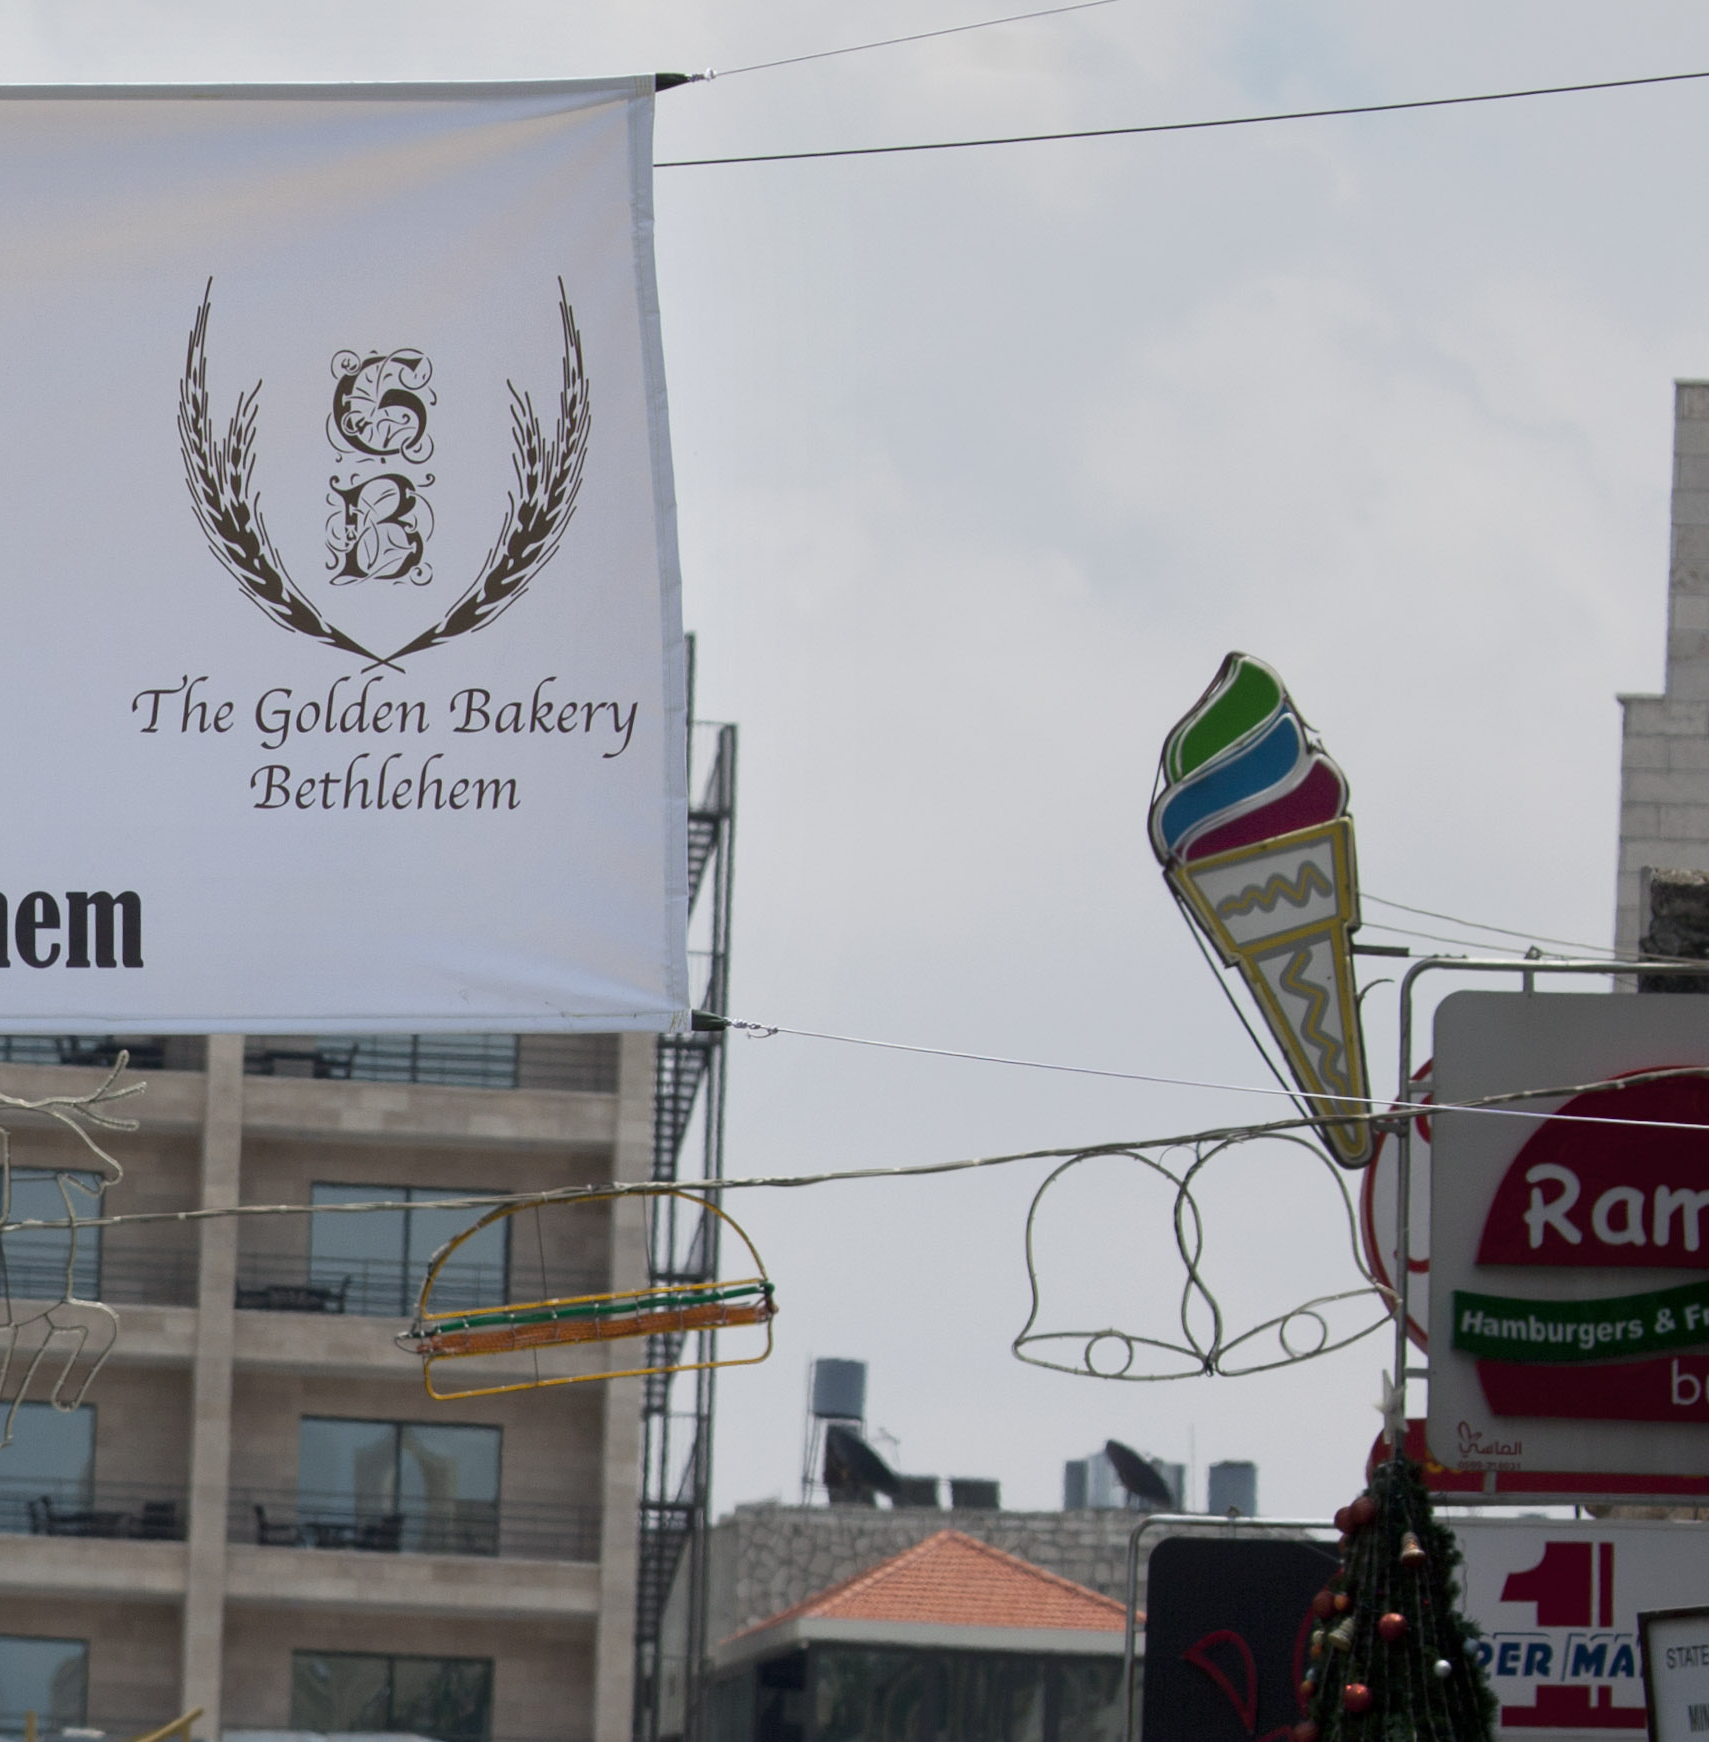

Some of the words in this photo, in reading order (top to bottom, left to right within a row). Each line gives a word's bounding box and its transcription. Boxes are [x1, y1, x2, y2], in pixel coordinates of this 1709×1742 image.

[131, 675, 235, 734] The
[254, 676, 430, 749] Golden
[448, 676, 639, 760] Bakery
[250, 752, 522, 811] Bethlehem
[1459, 1308, 1644, 1351] Hamburgers
[1653, 1306, 1676, 1335] &
[1683, 1303, 1709, 1331] F
[1671, 1356, 1709, 1406] b
[1479, 1640, 1553, 1678] PER
[1570, 1640, 1643, 1679] MA
